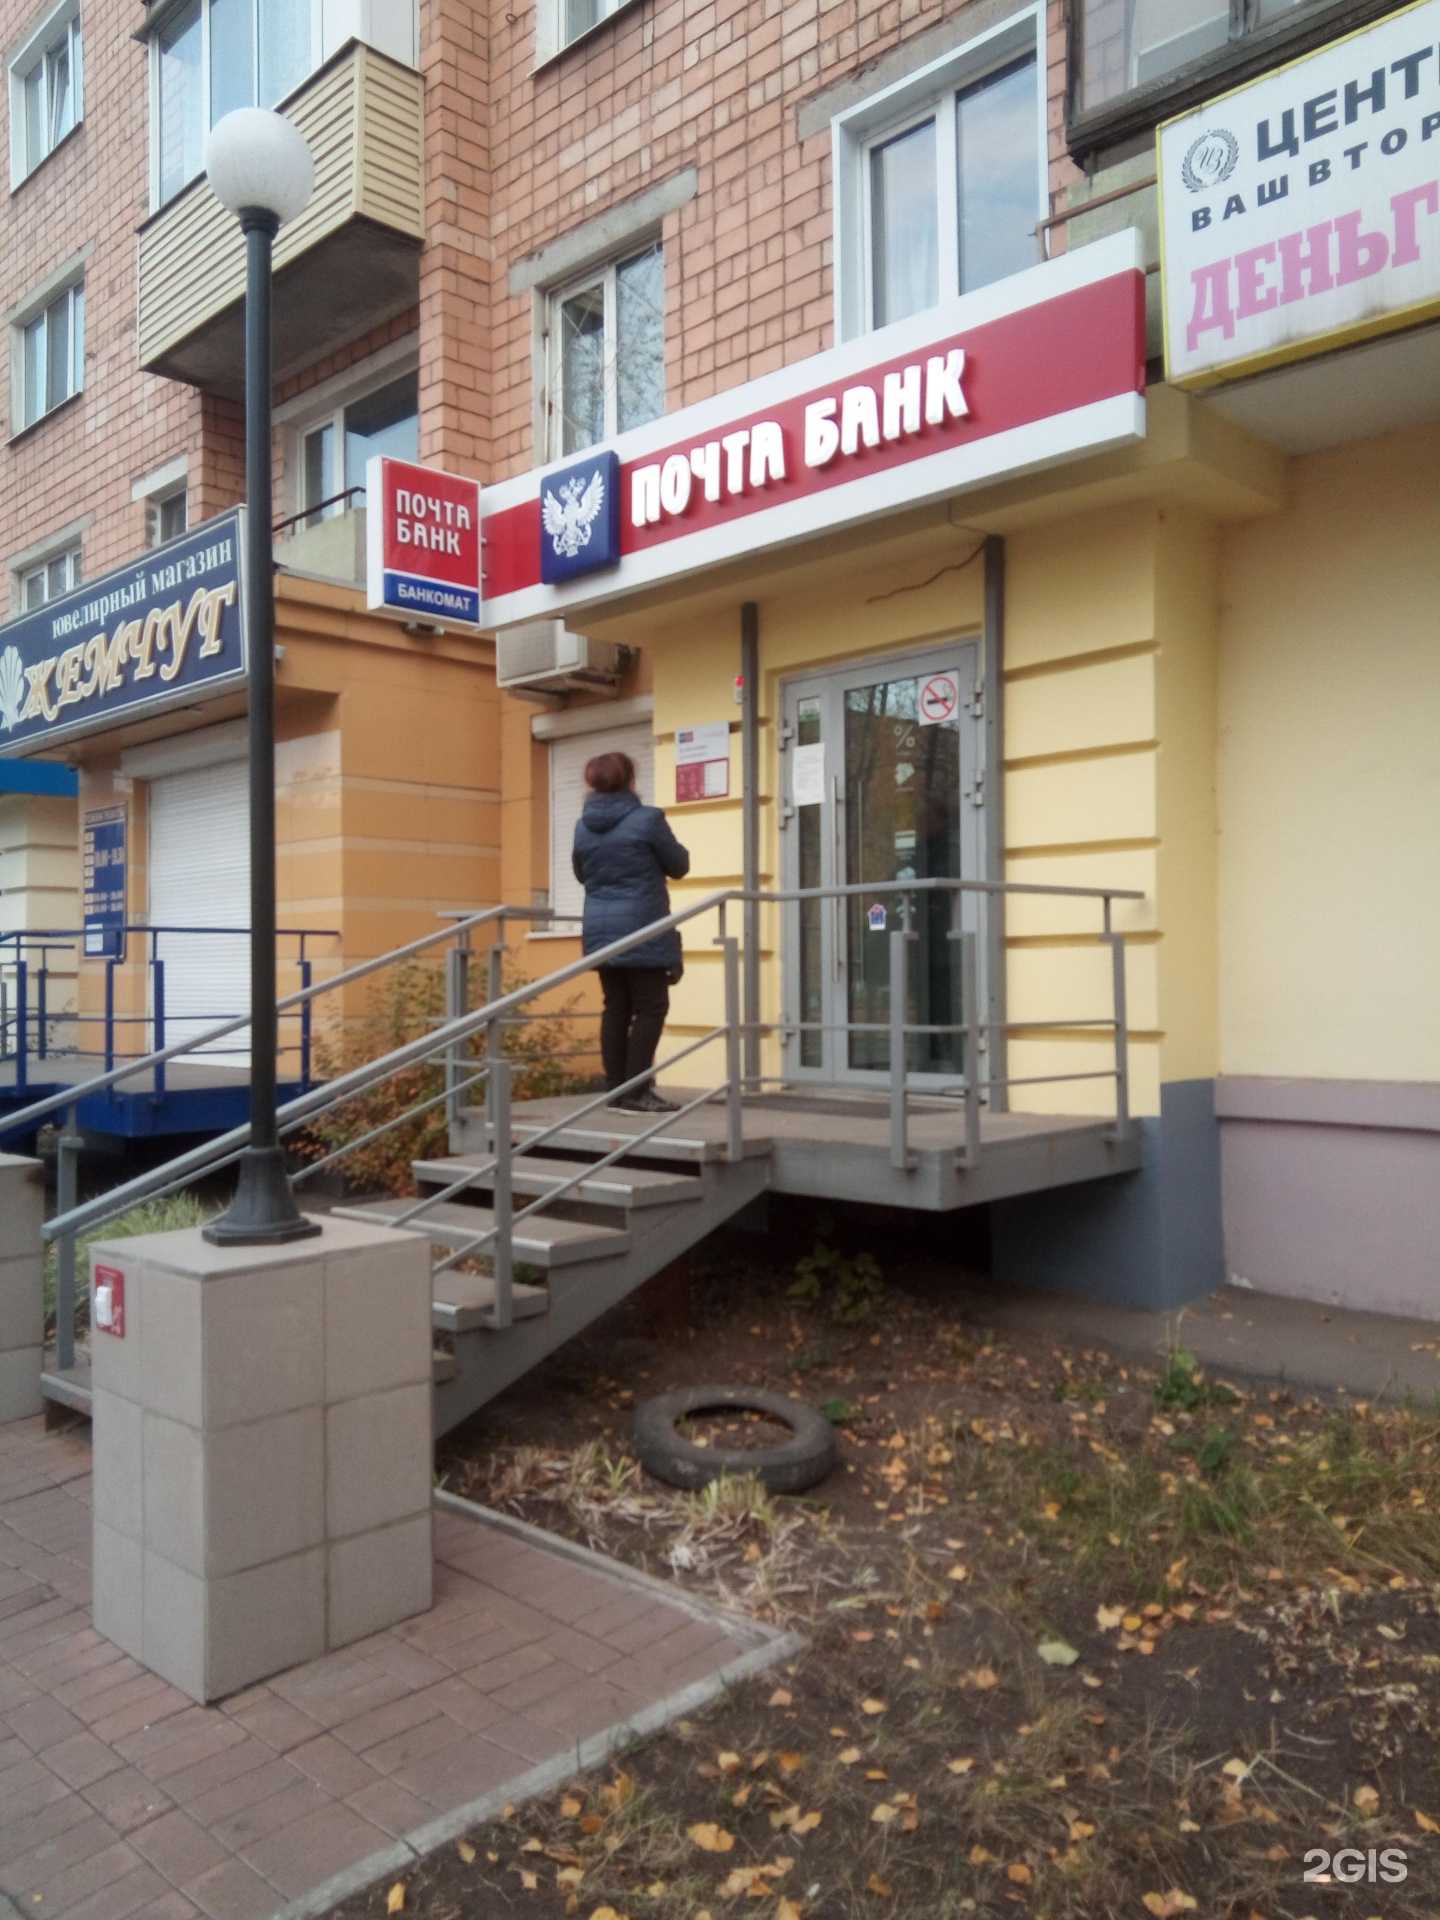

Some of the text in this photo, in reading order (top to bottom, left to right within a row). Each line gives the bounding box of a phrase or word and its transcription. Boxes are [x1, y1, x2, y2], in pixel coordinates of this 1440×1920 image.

[1256, 42, 1440, 162] ЦЕНТ
[1190, 174, 1290, 233] ВАШ
[630, 348, 969, 528] ПОЧТА БАНК
[396, 488, 471, 531] ПОЧТА
[397, 518, 461, 557] БАНК
[51, 538, 233, 640] ювелирный магазин
[397, 583, 472, 612] БАНКОМАТ
